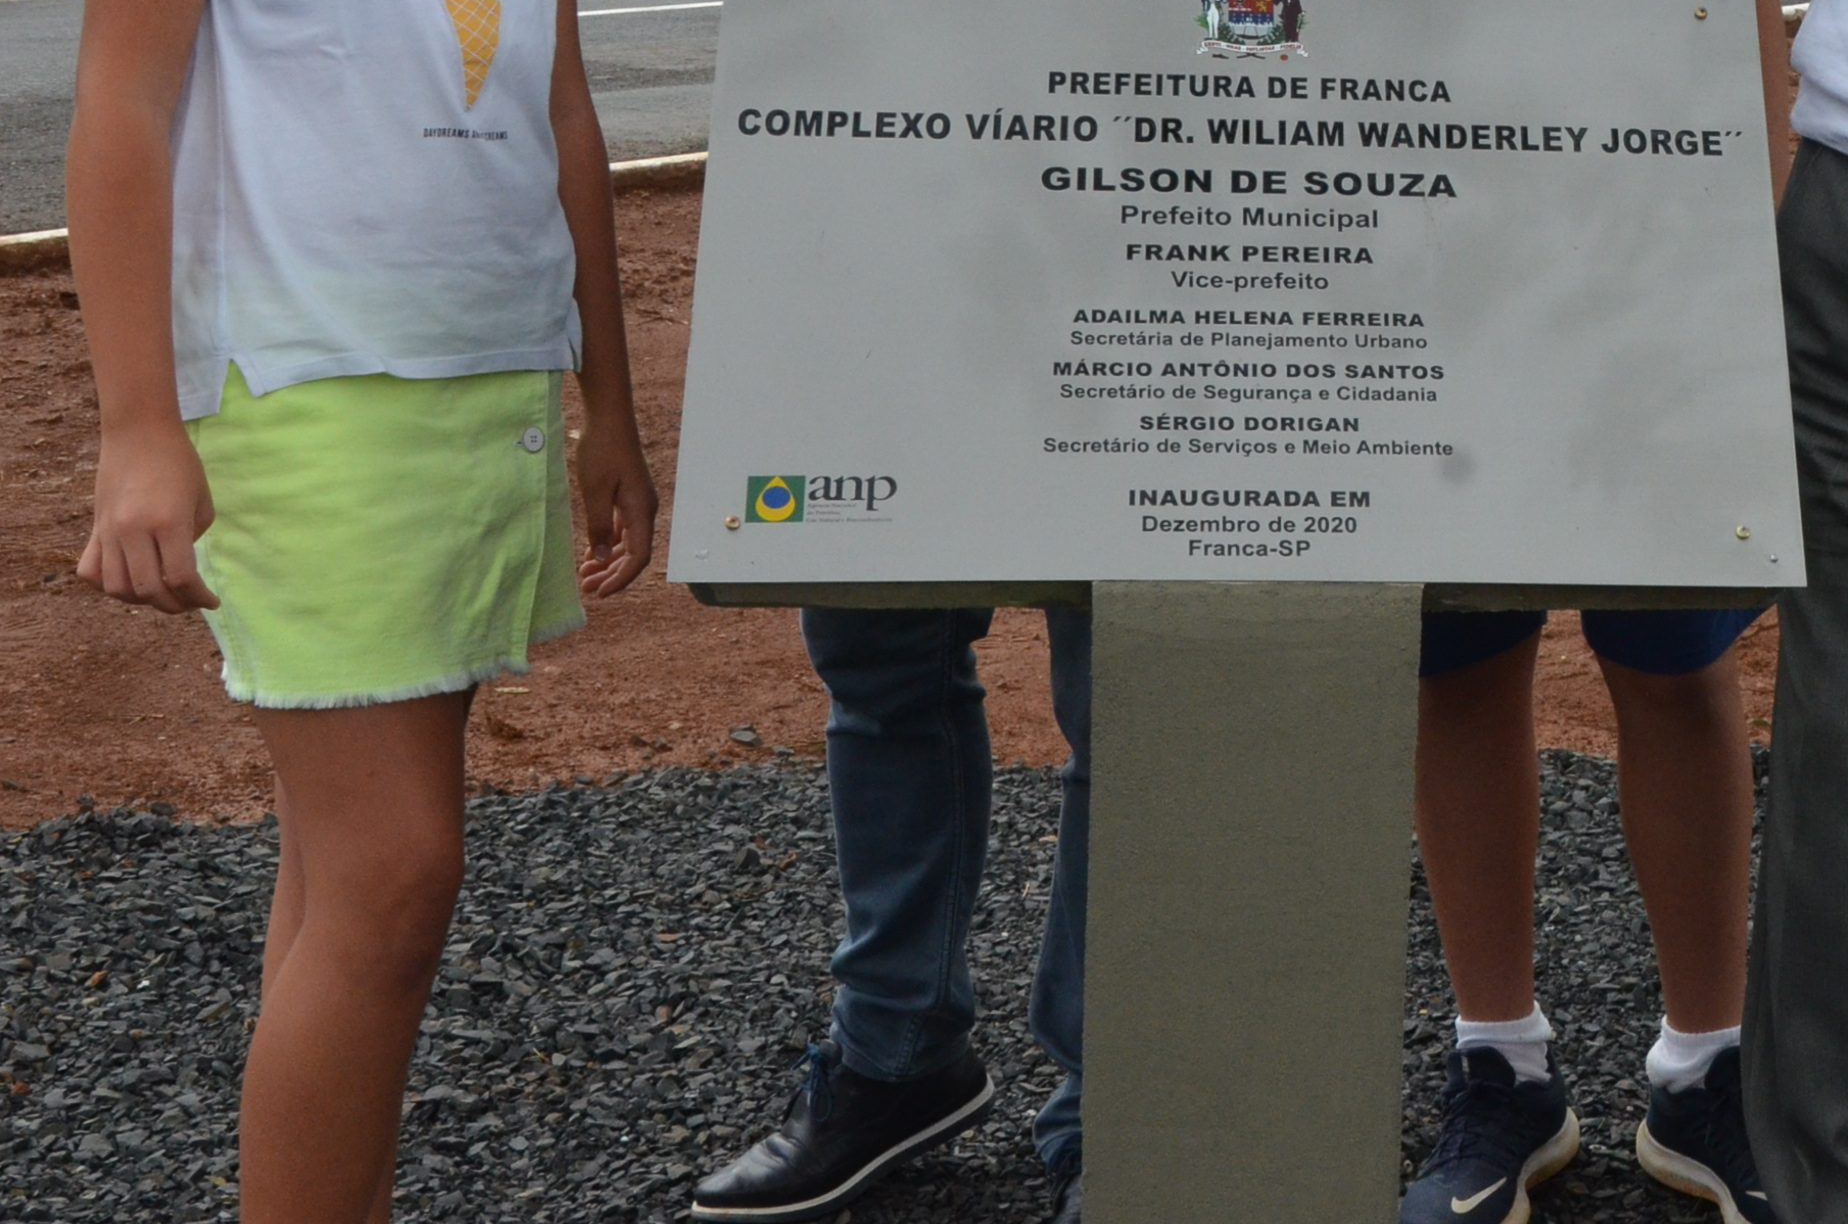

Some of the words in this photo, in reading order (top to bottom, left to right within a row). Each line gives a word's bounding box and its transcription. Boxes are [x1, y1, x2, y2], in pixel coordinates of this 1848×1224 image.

[1048, 70, 1257, 99] PREFEITURA
[1267, 75, 1309, 100] DE
[1320, 77, 1452, 103] FRANCA
[423, 127, 469, 139] DAYDREAMS
[737, 108, 951, 140] COMPLEXO
[964, 107, 1099, 143] VÍARIO
[1206, 118, 1345, 148] WILIAM
[1357, 121, 1589, 153] WANDERLEY
[1040, 166, 1213, 194] GILSON
[1230, 169, 1288, 195] DE
[1303, 170, 1458, 198] SOUZA
[1120, 204, 1232, 226] Prefeito
[1242, 206, 1379, 233] Municipal
[1126, 243, 1231, 263] FRANK
[1241, 245, 1374, 265] PEREIRA
[1170, 270, 1329, 293] Vice-prefeito
[1072, 308, 1186, 325] ADAILMA
[1194, 310, 1294, 326] HELENA
[1302, 311, 1425, 328] FERREIRA
[1070, 330, 1173, 346] Secretária
[1179, 331, 1205, 347] de
[1210, 331, 1348, 351] Planejamento
[1354, 333, 1428, 349] Urbano
[1052, 358, 1153, 377] MÁRCIO
[1160, 359, 1278, 378] ANTÔNIO
[1286, 363, 1336, 379] DOS
[1344, 363, 1445, 380] SANTOS
[1059, 383, 1166, 400] Secretário
[1171, 384, 1197, 400] de
[1203, 384, 1313, 404] Segurança
[1318, 389, 1330, 401] e
[1336, 385, 1437, 402] Cidadania
[1139, 412, 1235, 432] SÉRGIO
[1243, 416, 1360, 433] DORIGAN
[1043, 437, 1150, 454] Secretário
[1156, 437, 1182, 454] de
[1188, 437, 1278, 458] Serviços
[1284, 442, 1296, 455] e
[1302, 439, 1351, 455] Meio
[1355, 439, 1454, 457] Ambiente
[808, 475, 898, 512] anp
[1128, 489, 1321, 508] INAUGURADA
[1330, 490, 1371, 508] EM
[1141, 515, 1261, 533] Dezembro
[1267, 515, 1297, 534] de
[1303, 516, 1358, 534] 2020
[1188, 539, 1311, 557] Franca-SP
